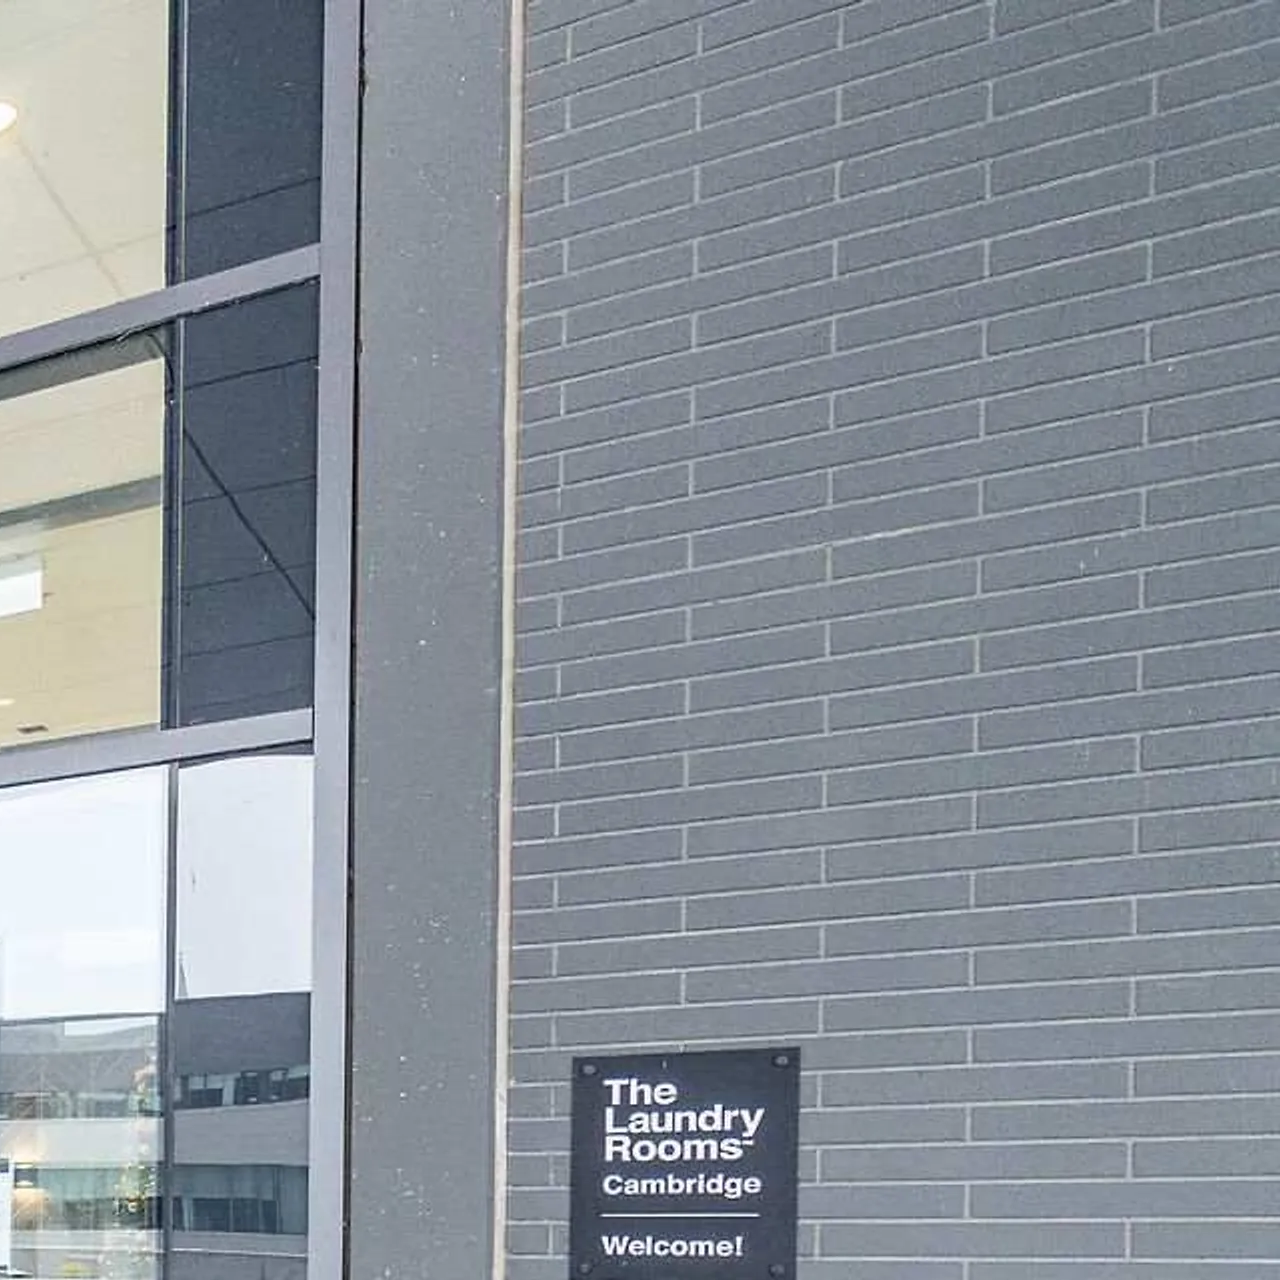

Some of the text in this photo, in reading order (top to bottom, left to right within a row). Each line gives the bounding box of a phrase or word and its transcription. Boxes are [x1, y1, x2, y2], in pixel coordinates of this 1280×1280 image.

[603, 1078, 677, 1105] The
[605, 1104, 765, 1137] Laundry
[602, 1174, 762, 1199] Cambridge
[601, 1236, 744, 1257] Welcome!
